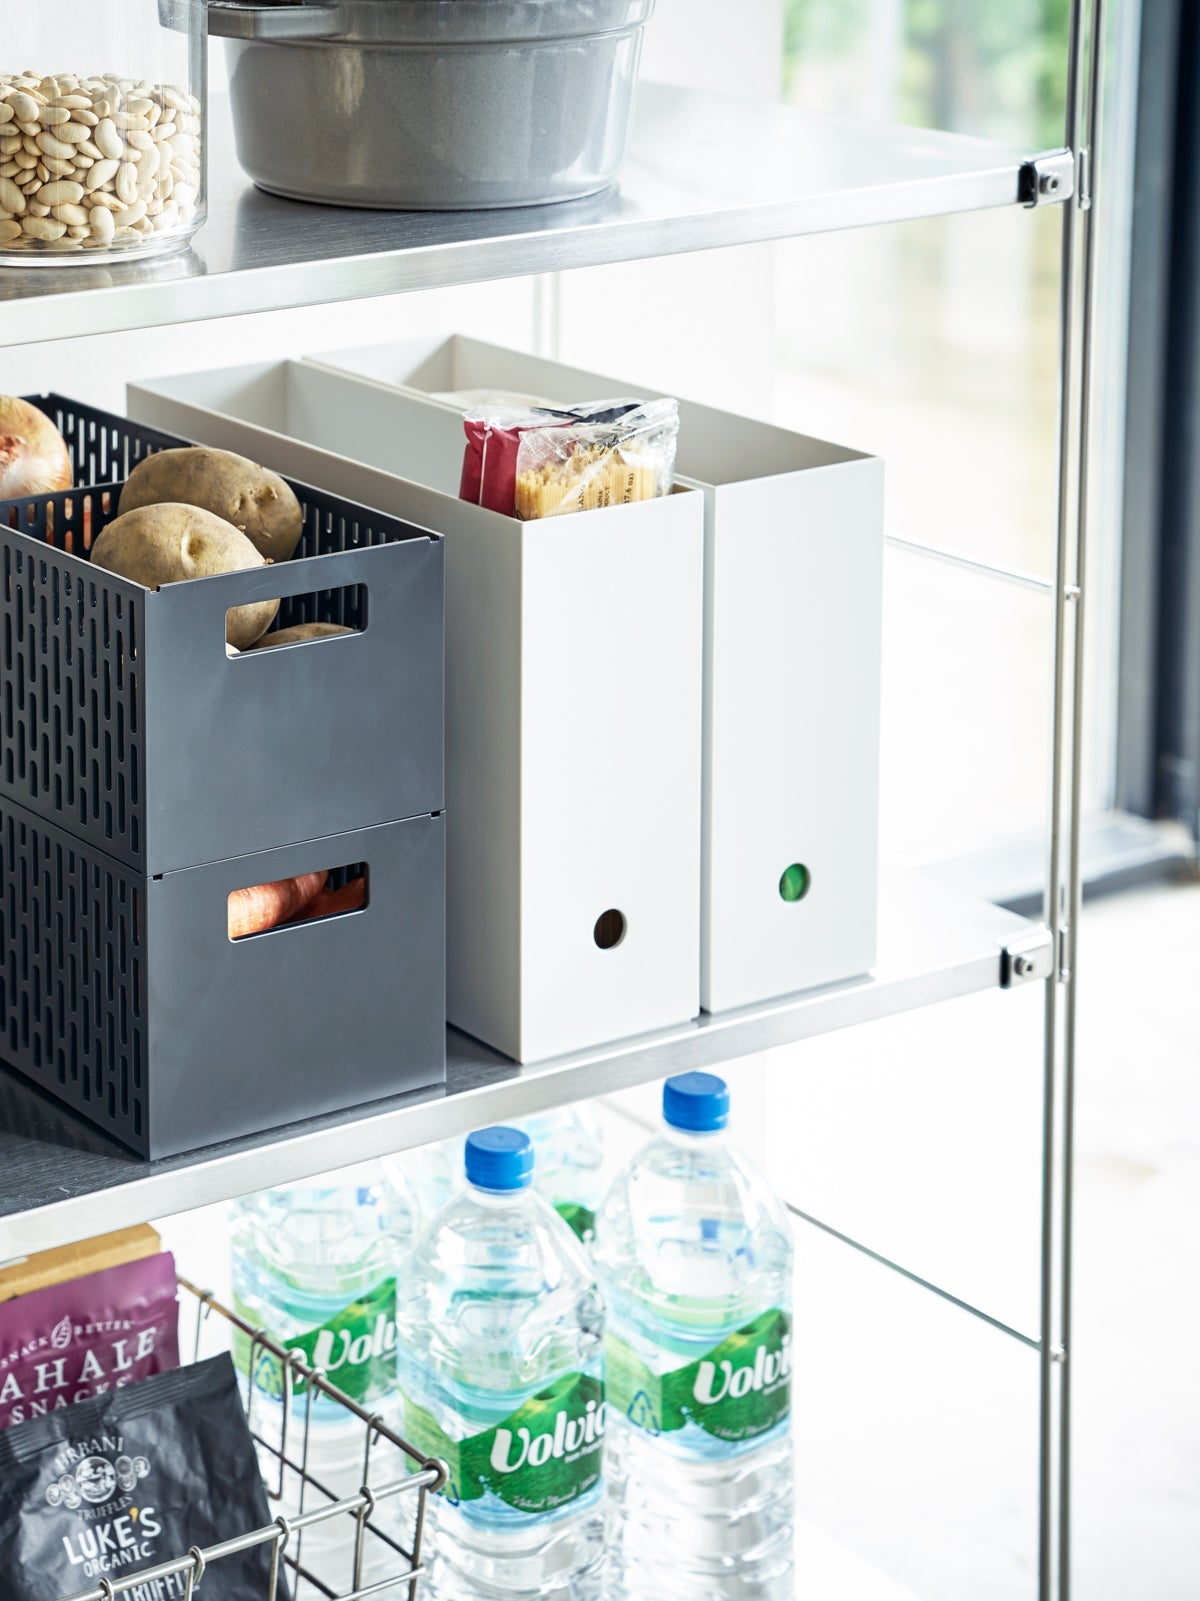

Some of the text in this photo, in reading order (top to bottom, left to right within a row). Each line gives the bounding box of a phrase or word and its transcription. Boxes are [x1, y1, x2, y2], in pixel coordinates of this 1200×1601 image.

[0, 1319, 133, 1369] SNACK BETTER
[54, 1436, 124, 1471] URBANI
[76, 1494, 133, 1522] TRUFFLES
[62, 1507, 162, 1565] LUKE'S
[82, 1541, 153, 1577] ORGANIC
